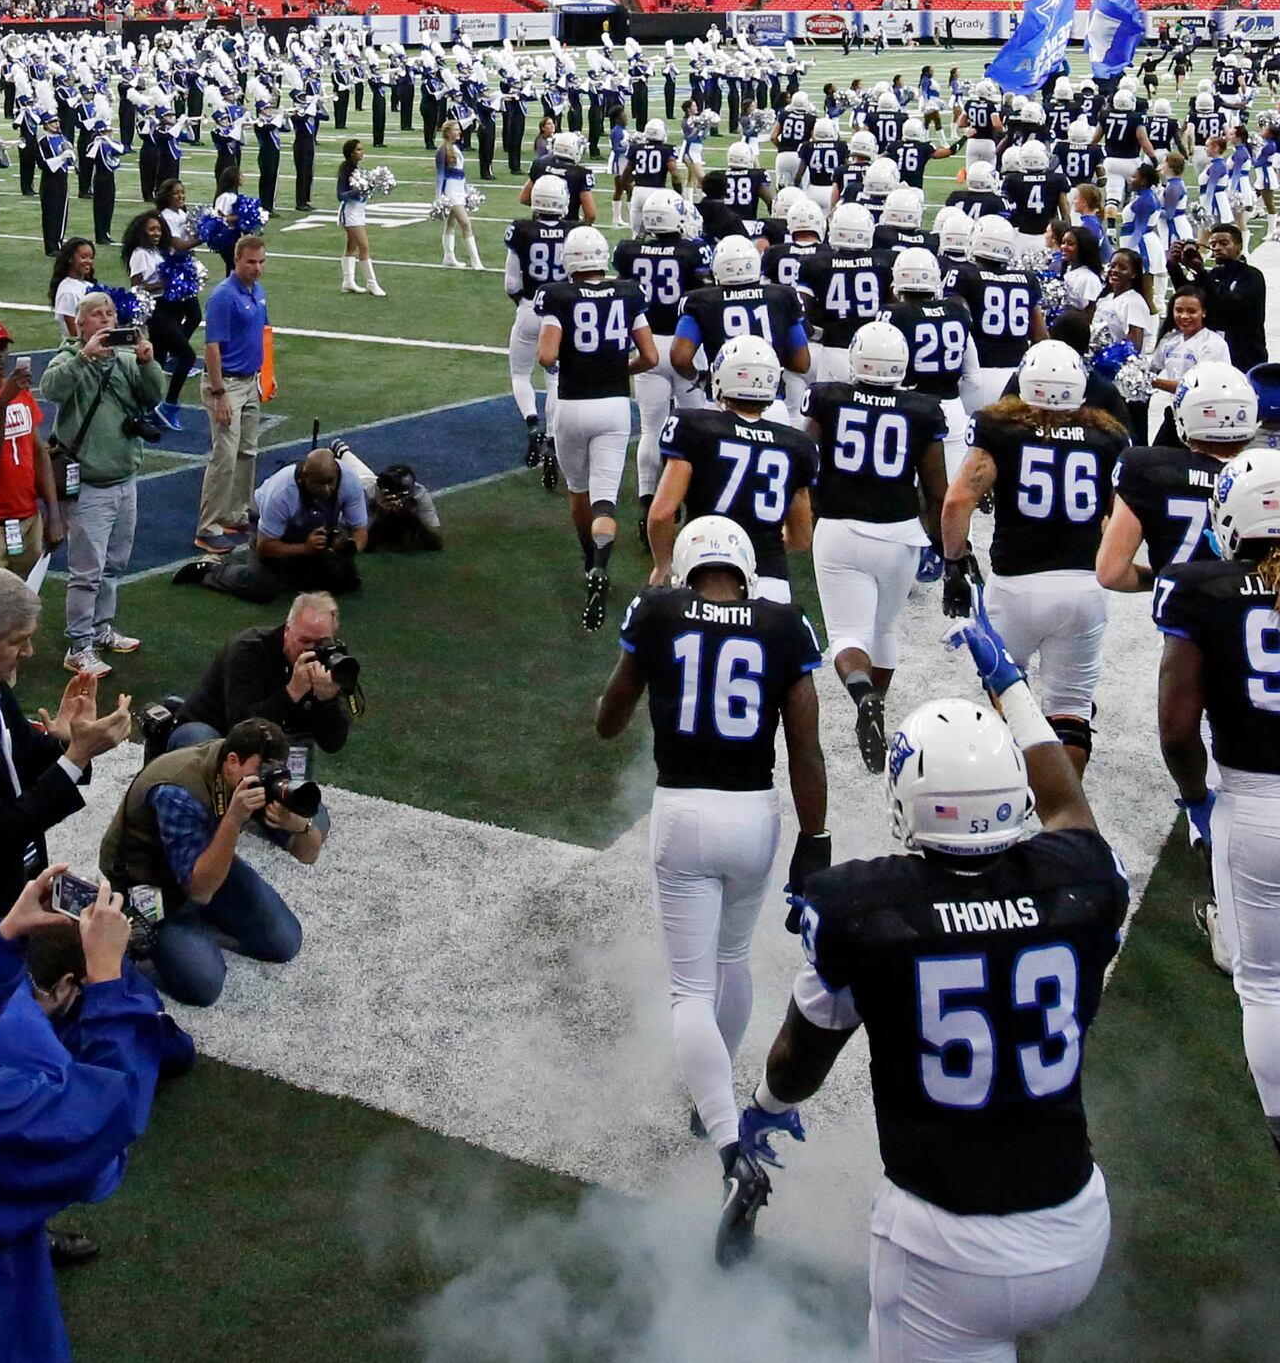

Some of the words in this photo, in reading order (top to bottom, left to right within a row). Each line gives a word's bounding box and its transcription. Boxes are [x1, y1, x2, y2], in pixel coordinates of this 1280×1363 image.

[955, 19, 984, 30] Grady
[967, 108, 987, 127] 90
[1049, 111, 1071, 132] 75
[1197, 118, 1220, 138] 48
[783, 118, 805, 140] 69
[876, 119, 897, 140] 10
[1106, 119, 1128, 140] 77
[1149, 120, 1169, 140] 21
[635, 149, 663, 174] 30
[810, 149, 839, 171] 40
[898, 148, 919, 170] 16
[1066, 152, 1090, 177] 81
[723, 177, 753, 205] 38
[1027, 186, 1045, 213] 4
[540, 228, 564, 239] ELDER
[640, 245, 676, 256] TRAYLOR
[789, 244, 817, 256] BROWN
[529, 242, 570, 282] 85
[832, 257, 873, 269] HAMILTON
[633, 258, 681, 305] 33
[979, 270, 1029, 285] DUCKWORTH
[723, 288, 765, 301] LAURENT
[825, 271, 880, 319] 49
[922, 305, 946, 318] WEST
[981, 286, 1030, 337] 86
[572, 299, 627, 354] 84
[914, 320, 967, 373] 28
[852, 391, 897, 408] PAXTON
[735, 423, 776, 444] MEYER
[834, 407, 909, 476] 50
[714, 442, 791, 523] 73
[1017, 445, 1098, 523] 56
[684, 599, 752, 627] J.SMITH
[672, 631, 765, 739] 16
[968, 818, 990, 835] 53
[933, 897, 1041, 935] THOMAS
[915, 941, 1083, 1110] 53
